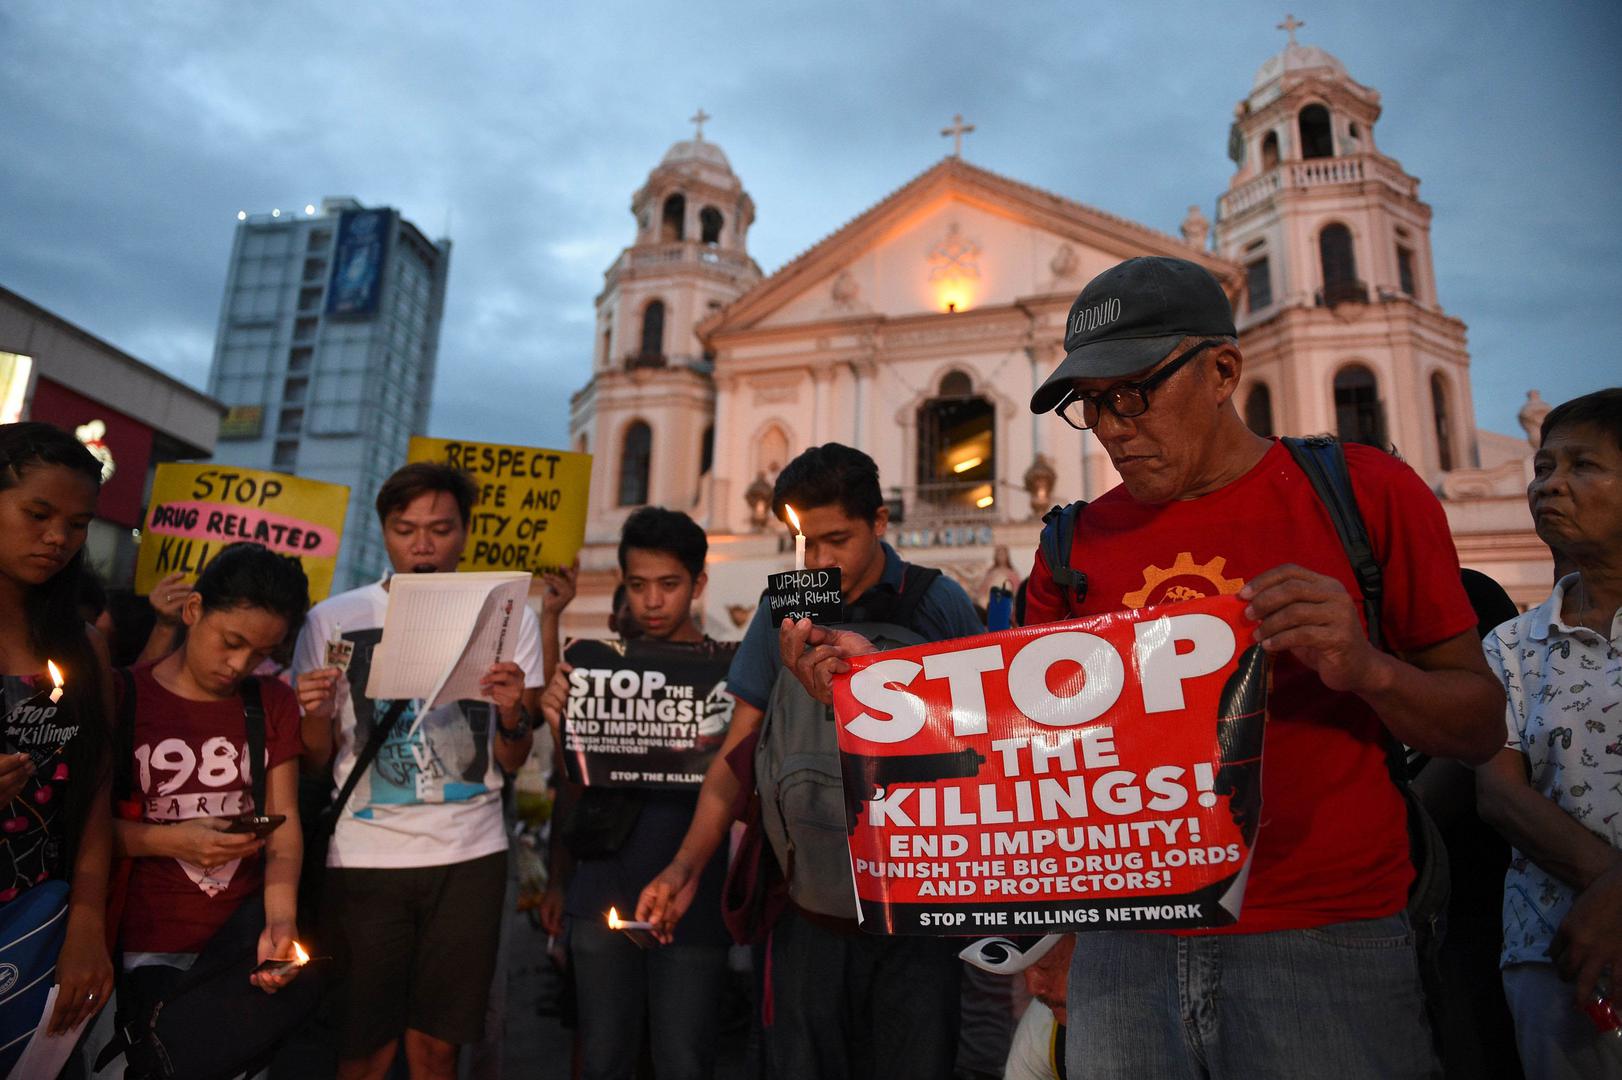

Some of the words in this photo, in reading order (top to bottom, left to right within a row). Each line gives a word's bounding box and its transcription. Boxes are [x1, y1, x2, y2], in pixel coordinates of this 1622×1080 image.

[445, 443, 561, 479] RESPECT
[192, 471, 283, 506] STOP
[521, 489, 561, 511] AND
[152, 504, 199, 530] DRUG
[206, 511, 321, 550] RELATED
[517, 518, 548, 540] OF
[473, 541, 542, 568] POOR!
[776, 571, 829, 590] UPHOLD
[770, 592, 800, 610] HUMAN
[804, 590, 841, 606] RIGHTS
[569, 667, 667, 699] STOP
[664, 686, 694, 699] THE
[844, 613, 1236, 744] STOP
[6, 705, 58, 724] STOP
[567, 697, 704, 722] KILLINGS!
[18, 723, 80, 746] Killings!
[566, 720, 600, 734] END
[604, 721, 697, 738] IMPUNITY!
[587, 744, 648, 754] PROTECTORS!
[602, 736, 618, 746] THE
[638, 738, 663, 748] DRUG
[665, 739, 694, 748] LORDS
[992, 727, 1119, 777] THE
[610, 771, 640, 781] STOP
[643, 772, 664, 782] THE
[869, 762, 1218, 827] KILLINGS!
[890, 834, 968, 858] END
[980, 818, 1201, 856] IMPUNITY!
[856, 858, 949, 878] PUNISH
[958, 859, 1005, 876] THE
[1014, 856, 1058, 875] BIG
[1066, 853, 1143, 873] DRUG
[1152, 844, 1240, 868] LORDS
[917, 879, 975, 897] AND
[984, 870, 1172, 895] PROTECTORS!
[919, 912, 966, 927] STOP
[972, 911, 1007, 926] THE
[1014, 909, 1100, 925] KILLINGS
[1106, 904, 1202, 922] NETWORK
